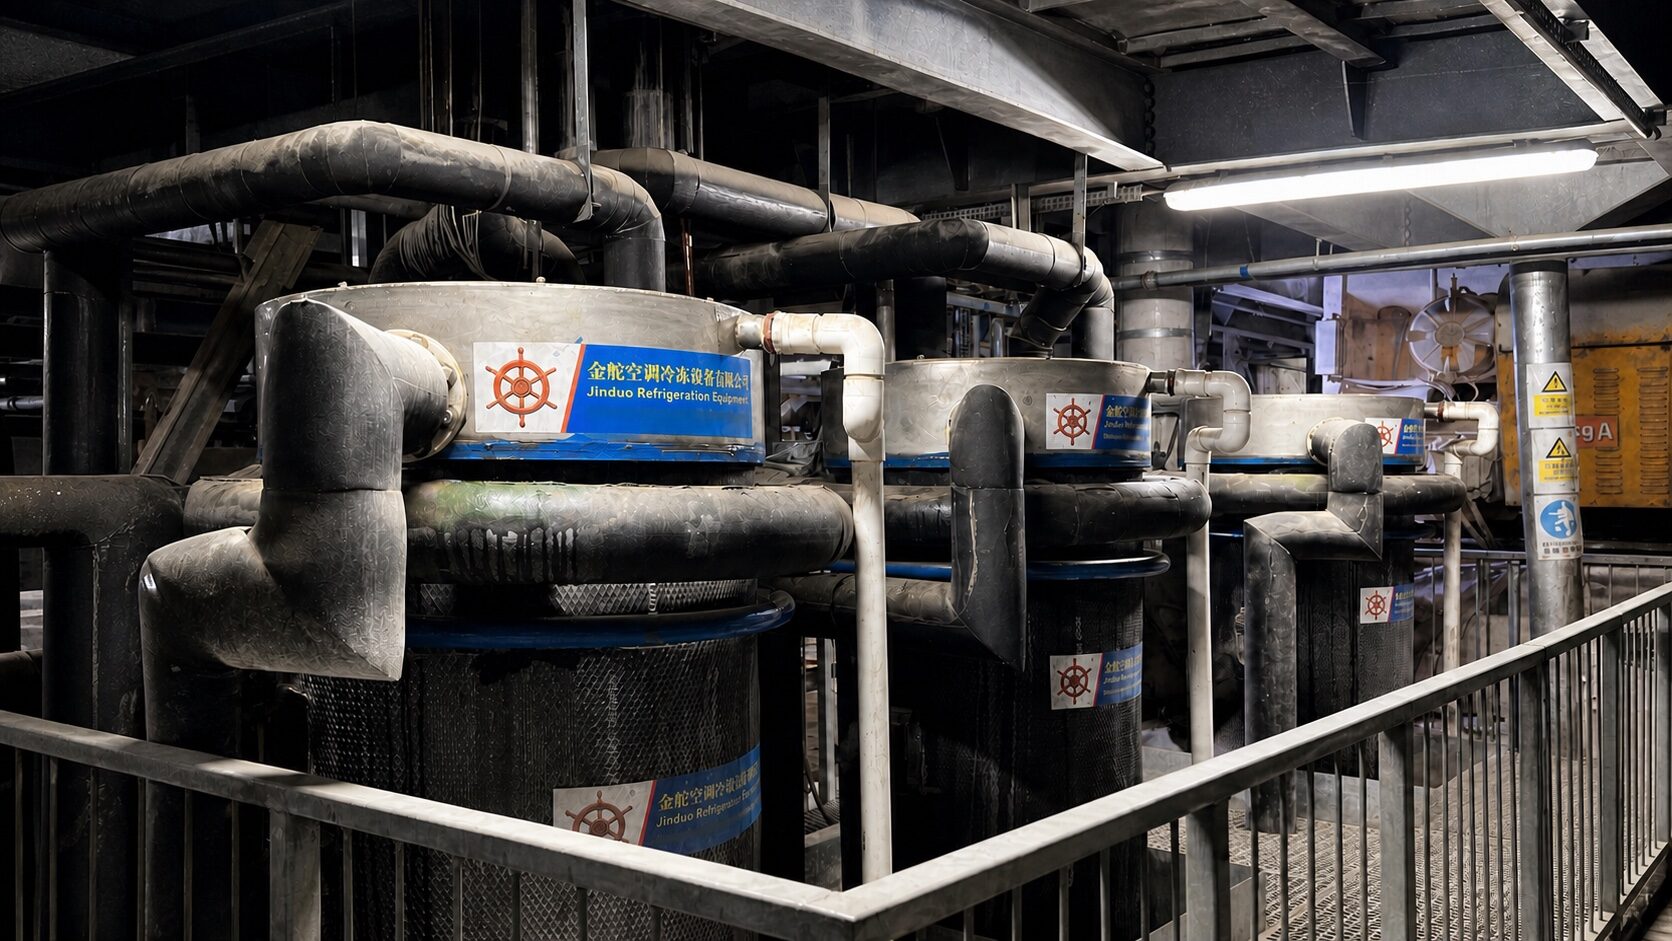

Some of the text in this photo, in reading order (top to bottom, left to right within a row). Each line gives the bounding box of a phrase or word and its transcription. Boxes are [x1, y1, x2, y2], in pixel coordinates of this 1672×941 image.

[586, 386, 633, 398] Jinduo
[637, 387, 710, 403] Refrigeration
[656, 812, 694, 828] Jinduo
